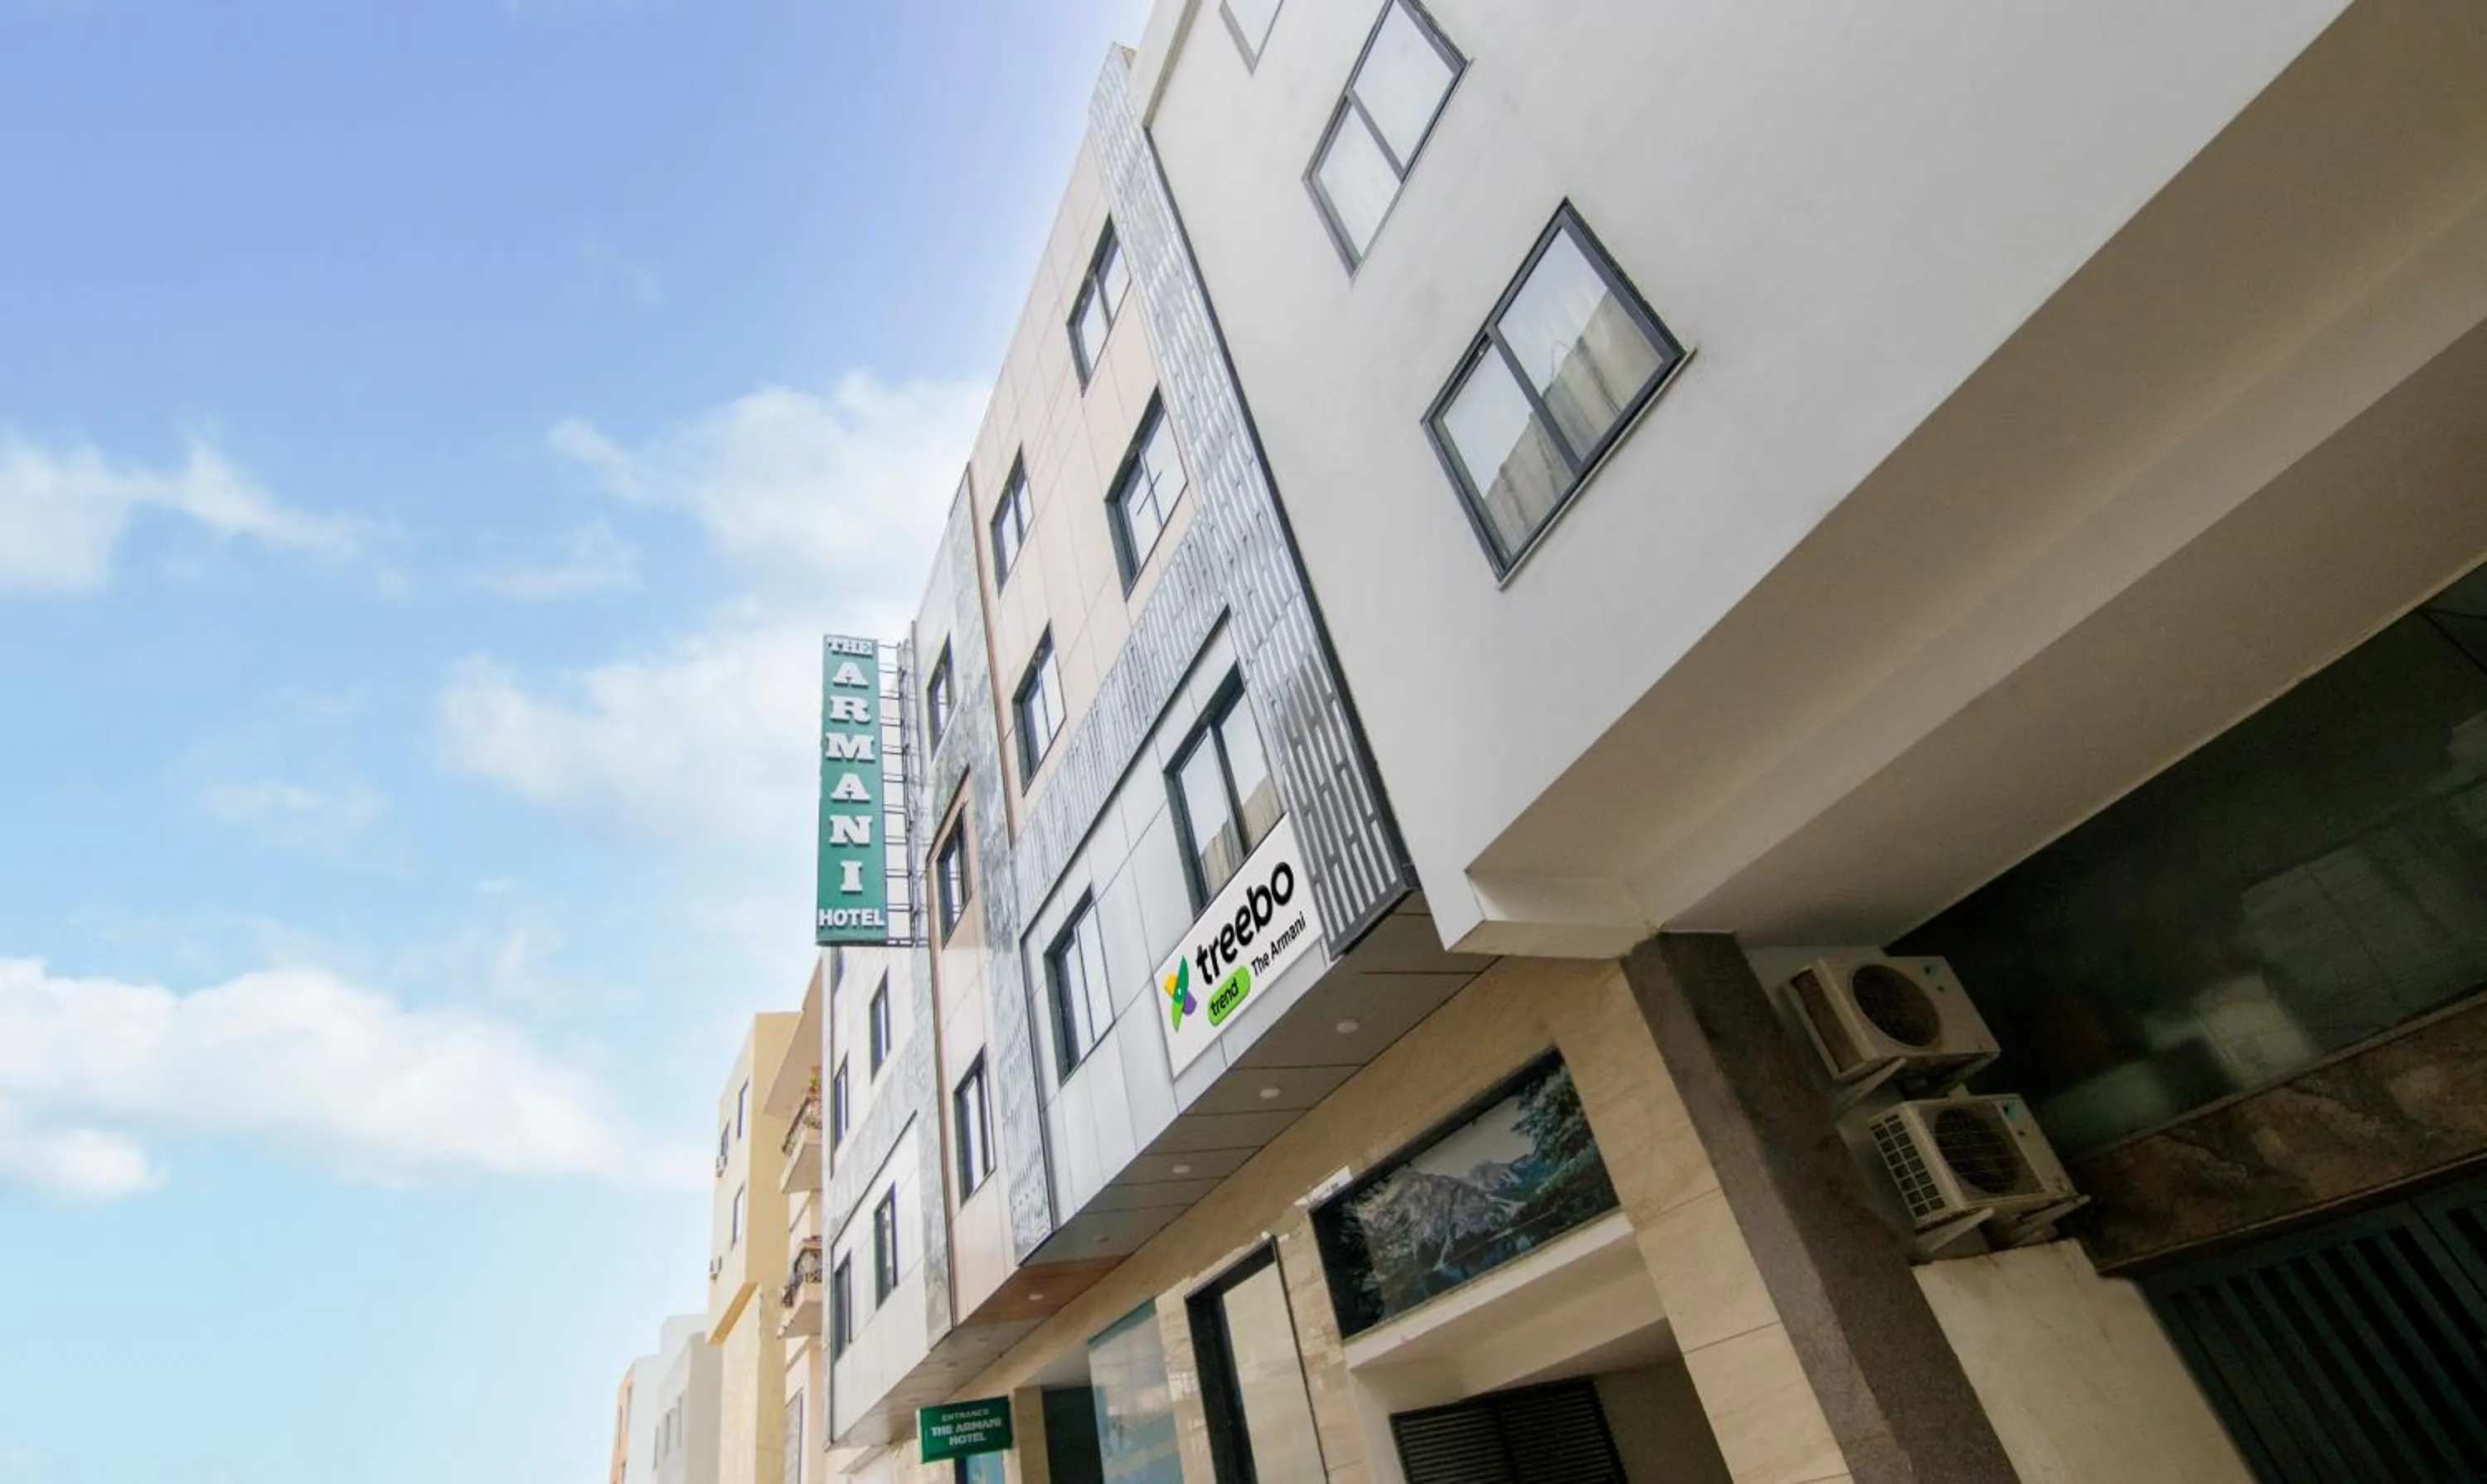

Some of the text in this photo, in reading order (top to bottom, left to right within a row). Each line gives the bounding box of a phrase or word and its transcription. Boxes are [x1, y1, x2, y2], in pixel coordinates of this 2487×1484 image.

[828, 638, 873, 654] THE
[825, 662, 875, 893] ARMANI
[819, 908, 885, 927] HOTEL
[1195, 861, 1294, 985] treebo
[1251, 911, 1307, 977] The Armani
[1210, 977, 1239, 1016] trend
[942, 1408, 990, 1422] ENTRANCE
[931, 1418, 1002, 1437] THE ARMANI
[949, 1432, 987, 1446] HOTEL
